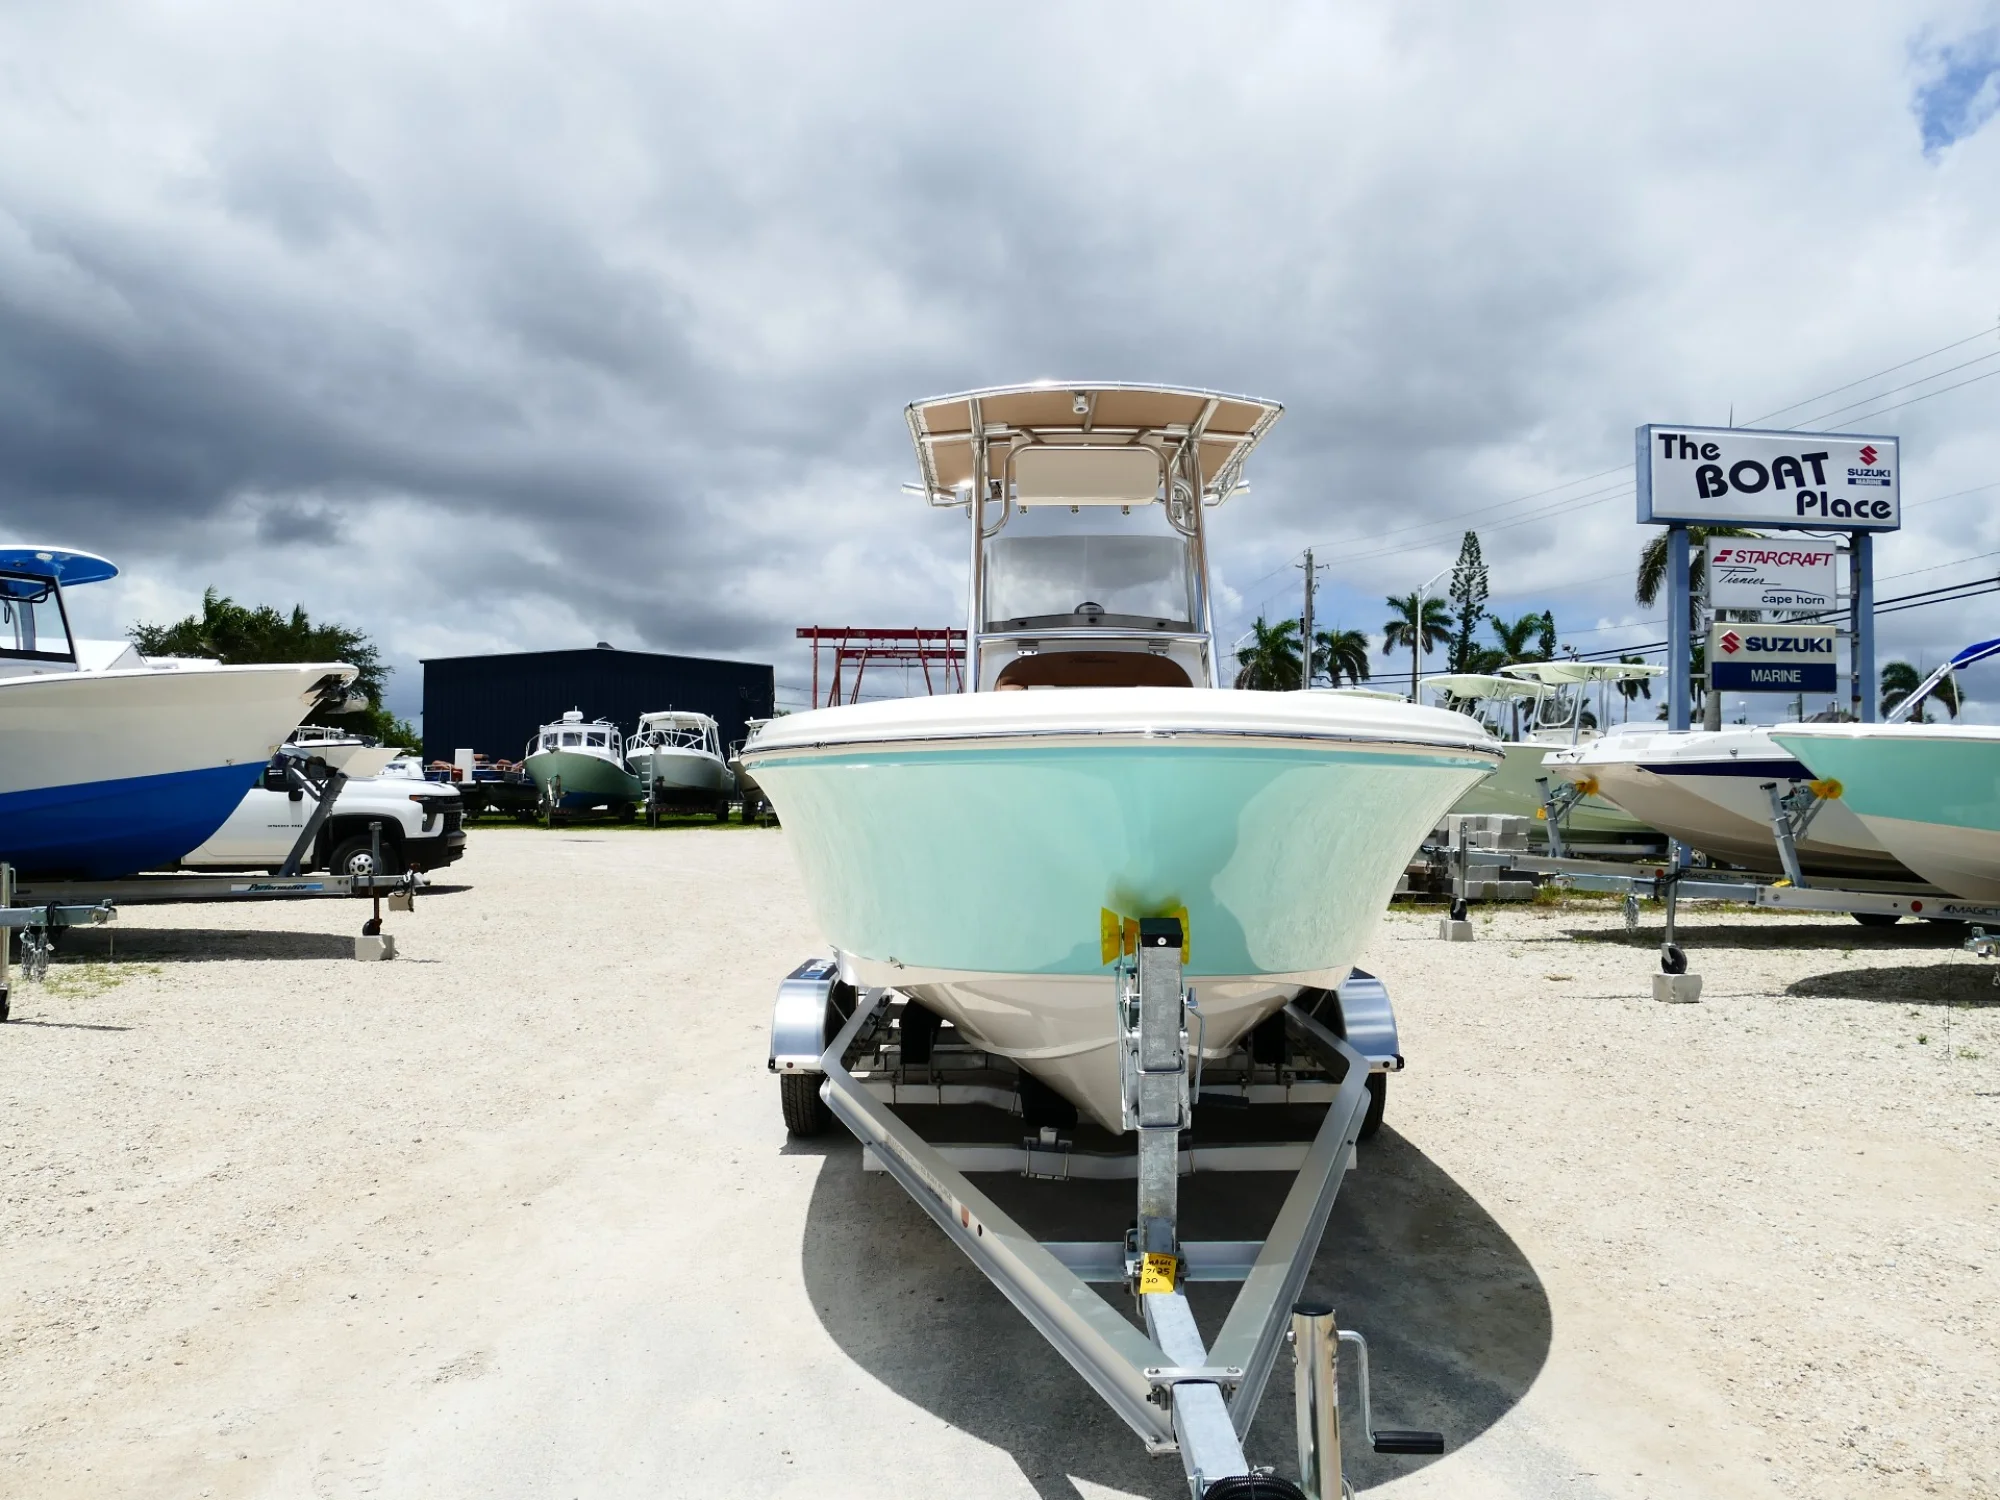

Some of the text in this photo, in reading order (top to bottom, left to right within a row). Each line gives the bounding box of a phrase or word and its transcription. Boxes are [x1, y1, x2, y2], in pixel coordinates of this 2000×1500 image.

[1658, 434, 1721, 461] The
[1695, 451, 1829, 499] BOAT
[1847, 468, 1891, 477] SUZUKI
[1796, 490, 1893, 519] Place
[1735, 550, 1834, 567] STARCRAFT
[1712, 565, 1781, 585] Pioneer
[1761, 595, 1825, 605] cape horn
[1745, 637, 1832, 653] SUZUKI
[1751, 669, 1802, 683] MARINE
